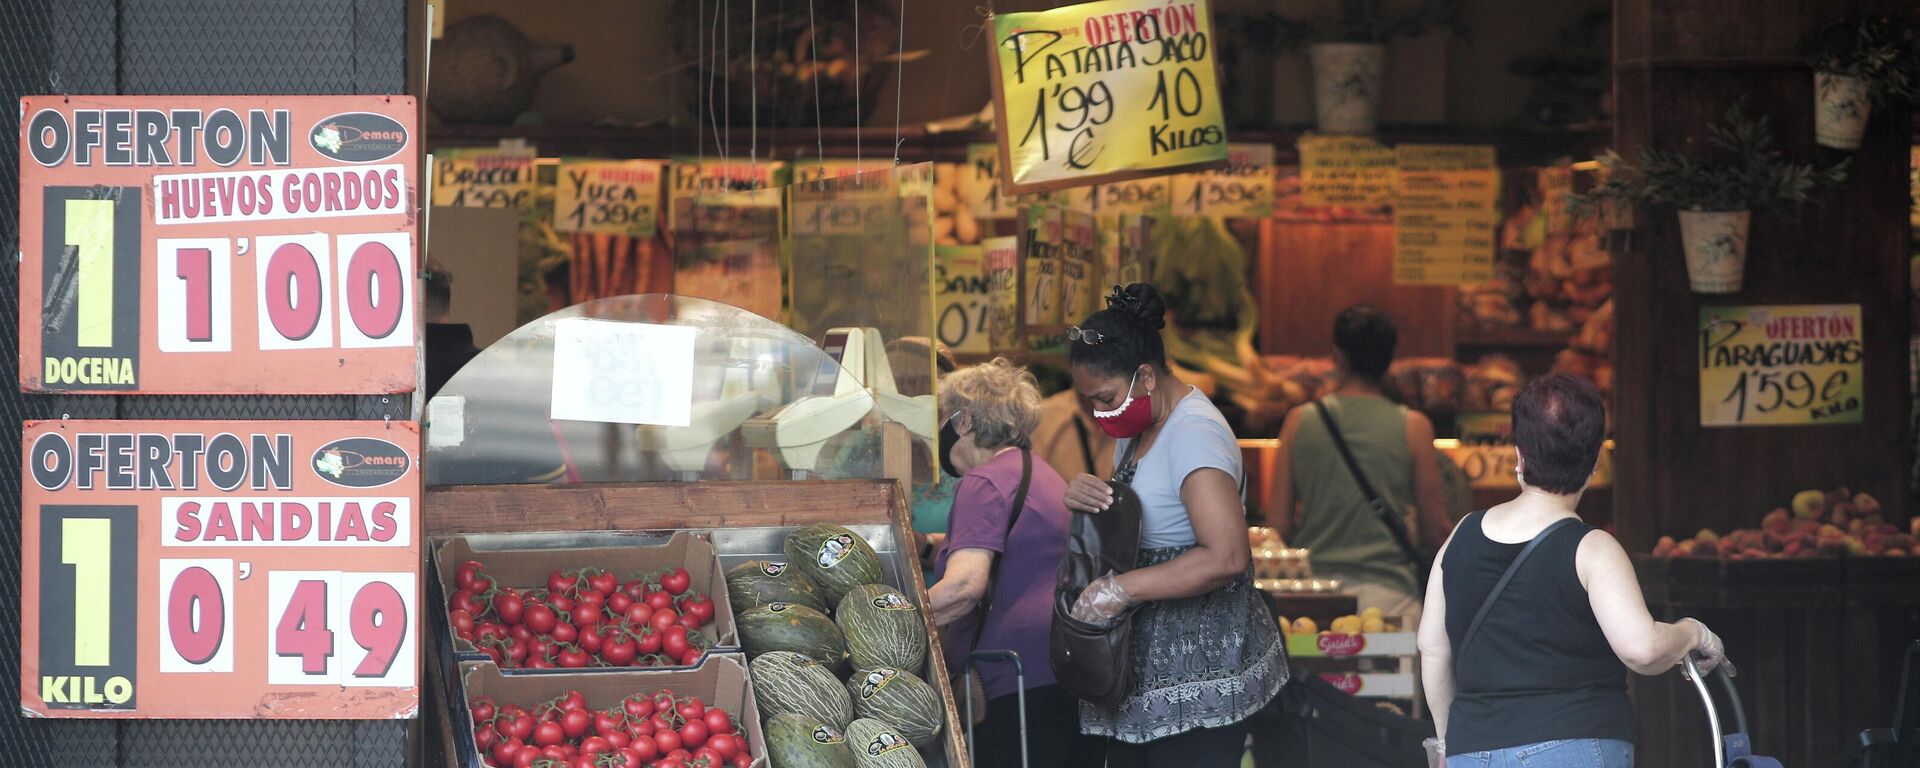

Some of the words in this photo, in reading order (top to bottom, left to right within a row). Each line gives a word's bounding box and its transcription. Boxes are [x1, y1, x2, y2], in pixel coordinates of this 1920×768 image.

[1001, 30, 1136, 84] PATATA
[1136, 14, 1207, 66] SACO
[28, 108, 292, 167] OFERTON
[1018, 80, 1114, 161] 1'99
[1146, 67, 1201, 121] 10
[1150, 124, 1223, 156] KILOS
[1063, 127, 1105, 170] €
[161, 175, 273, 220] HUEVOS
[282, 168, 400, 214] GORDOS
[568, 168, 637, 202] YUCA
[64, 199, 114, 348] 1
[176, 237, 404, 342] 1'00
[1698, 319, 1863, 369] PARAGUAYAS
[44, 356, 135, 385] DOCENA
[1810, 396, 1859, 420] KILO
[30, 432, 294, 491] OFERTON
[174, 502, 398, 543] SANDIAS
[62, 518, 111, 667] 1
[167, 561, 408, 678] 0'49
[42, 675, 133, 705] KILO
